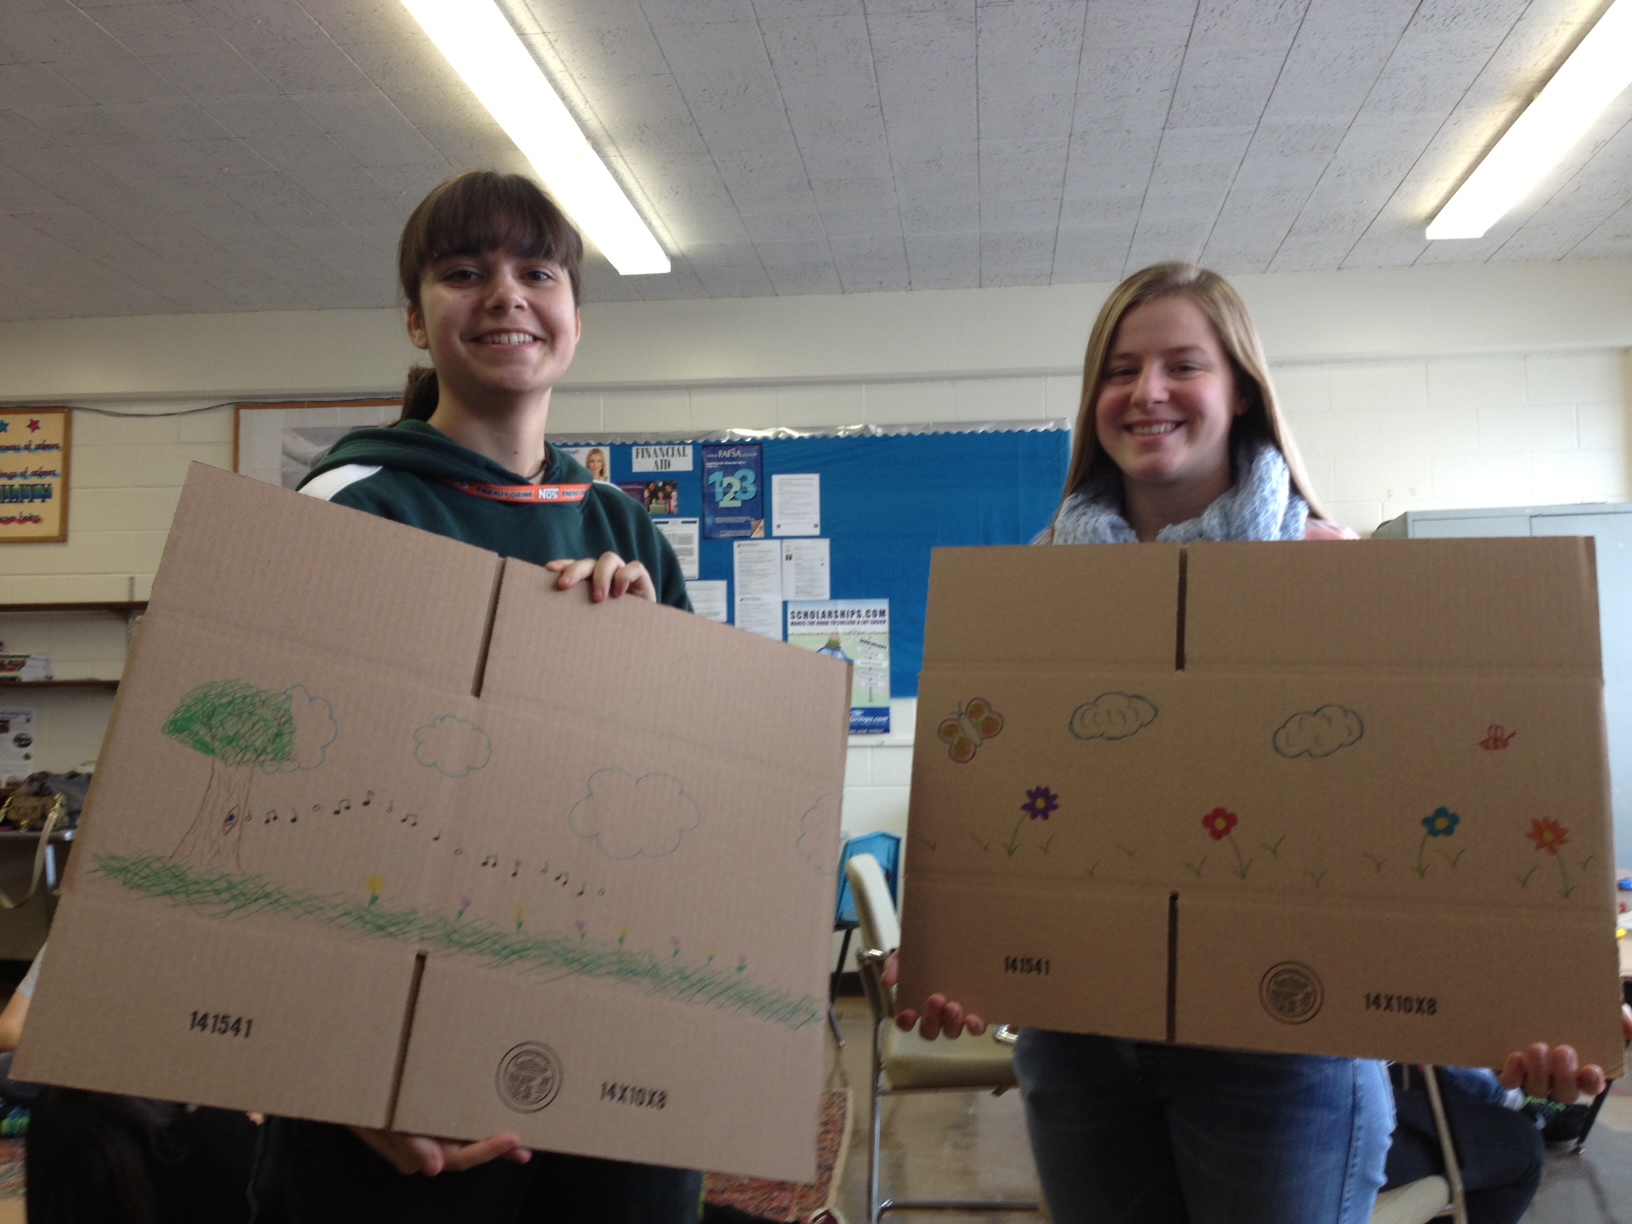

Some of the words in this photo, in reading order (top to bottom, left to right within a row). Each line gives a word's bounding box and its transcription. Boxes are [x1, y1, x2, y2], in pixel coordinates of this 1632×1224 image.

[635, 446, 688, 459] FINANCIAL
[653, 458, 671, 470] AID
[476, 486, 508, 497] ENERGY
[510, 490, 534, 499] DRINK
[789, 608, 886, 620] SCHOLARSHIPS.COM
[1004, 956, 1050, 977] 141541
[1364, 992, 1438, 1016] 14X10X8
[189, 1010, 254, 1039] 141541
[599, 1081, 669, 1111] 14X10X8
